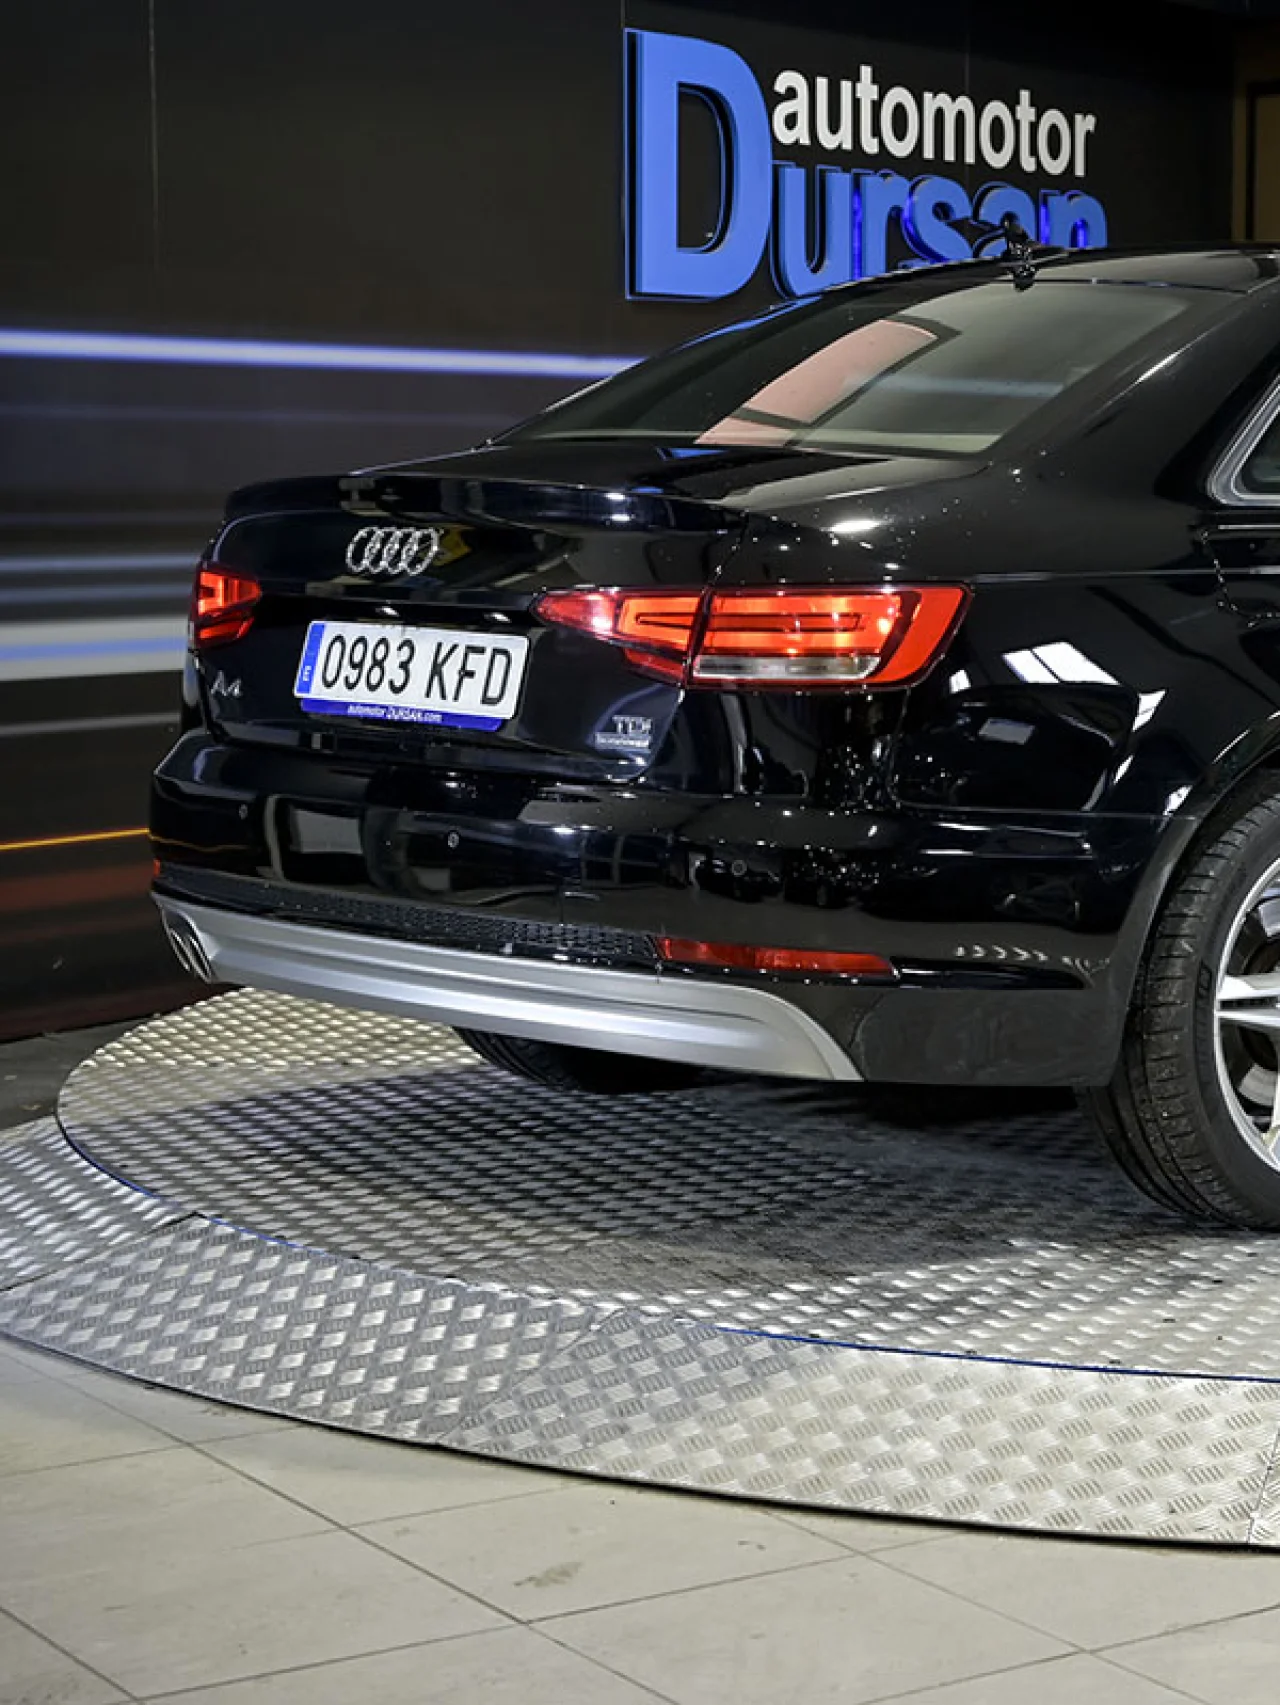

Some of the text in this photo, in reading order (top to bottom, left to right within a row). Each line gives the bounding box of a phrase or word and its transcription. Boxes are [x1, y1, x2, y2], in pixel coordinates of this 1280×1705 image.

[772, 64, 1096, 178] automotor
[210, 669, 242, 697] A4
[321, 633, 513, 706] 0983 KFD
